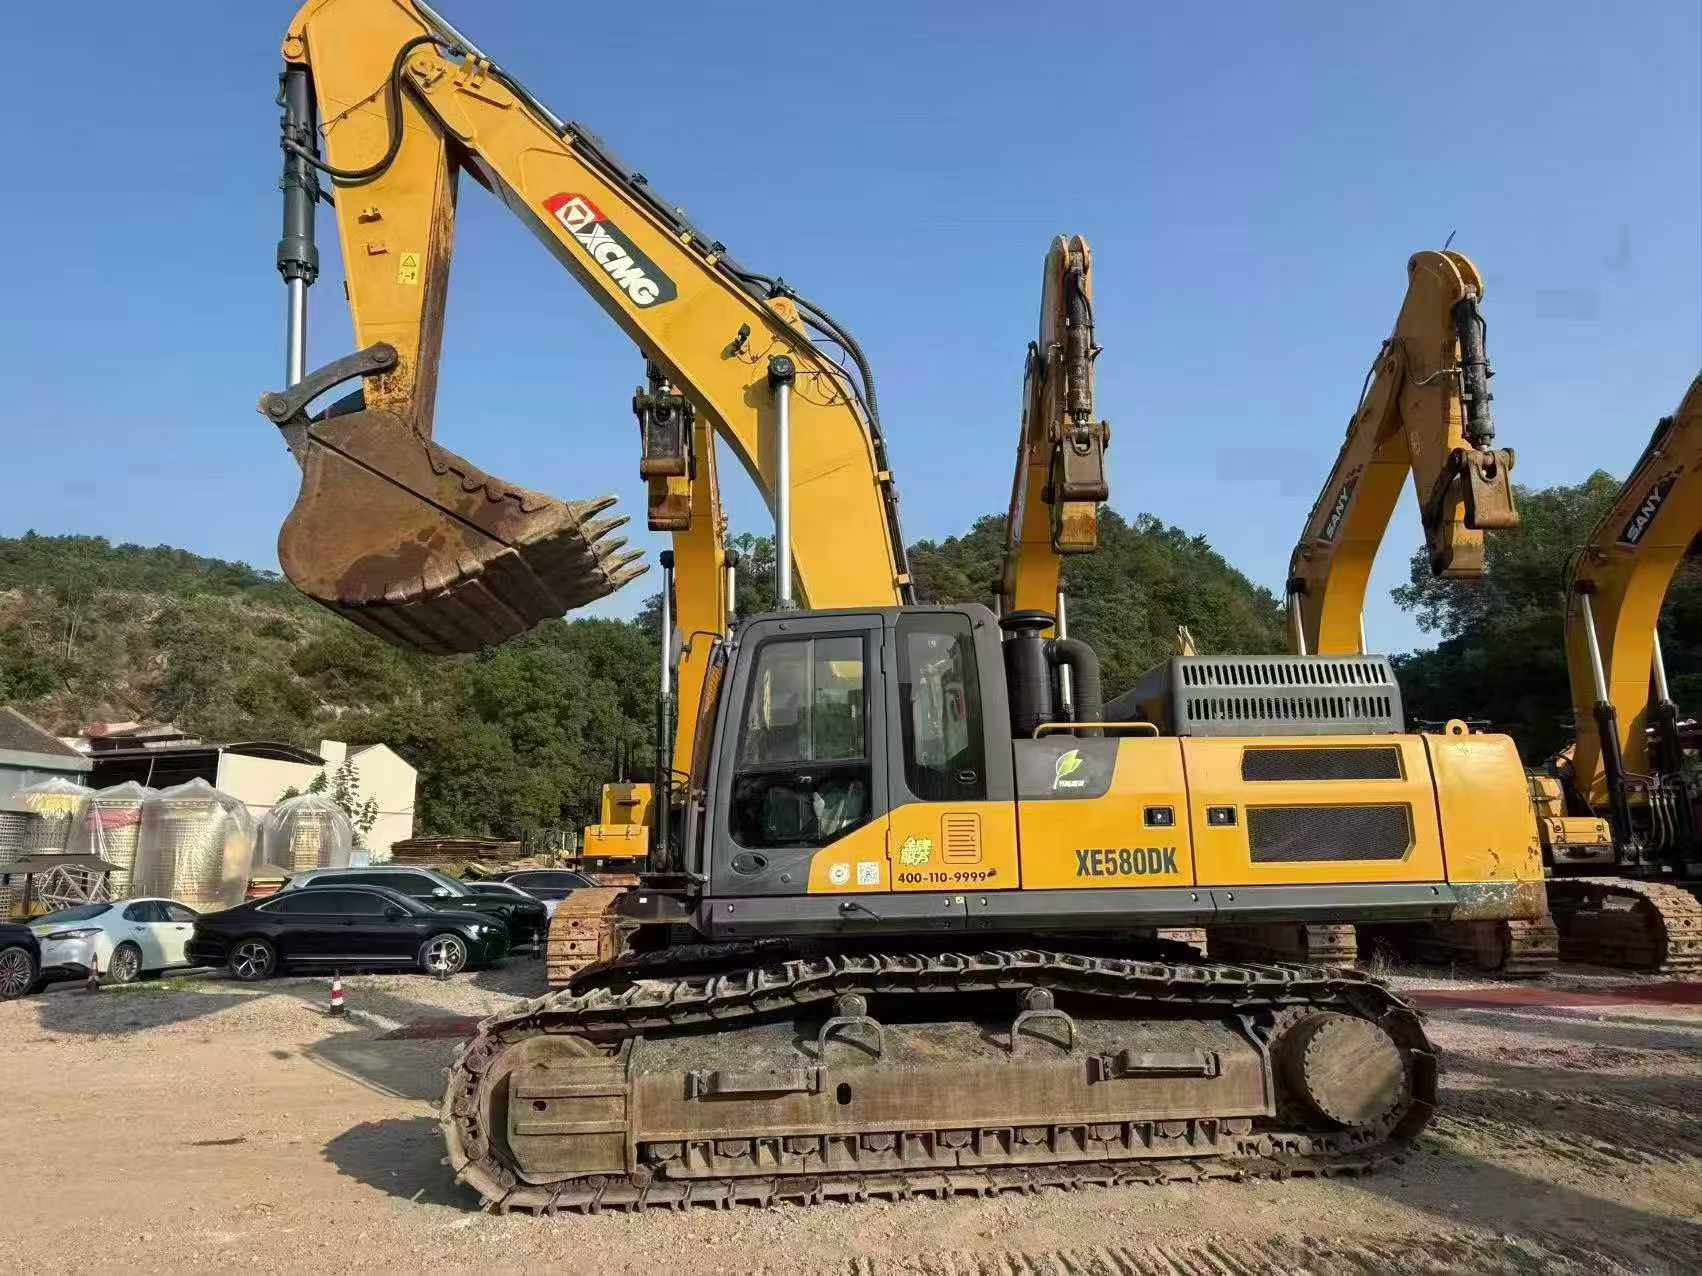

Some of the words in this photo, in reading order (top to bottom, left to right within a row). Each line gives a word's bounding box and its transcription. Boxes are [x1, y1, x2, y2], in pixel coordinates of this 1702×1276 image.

[574, 222, 660, 305] XCMG
[1326, 486, 1349, 539] SANY
[1626, 486, 1661, 543] SANY
[898, 871, 987, 884] 400-110-9999
[1075, 847, 1179, 877] XE580DK
